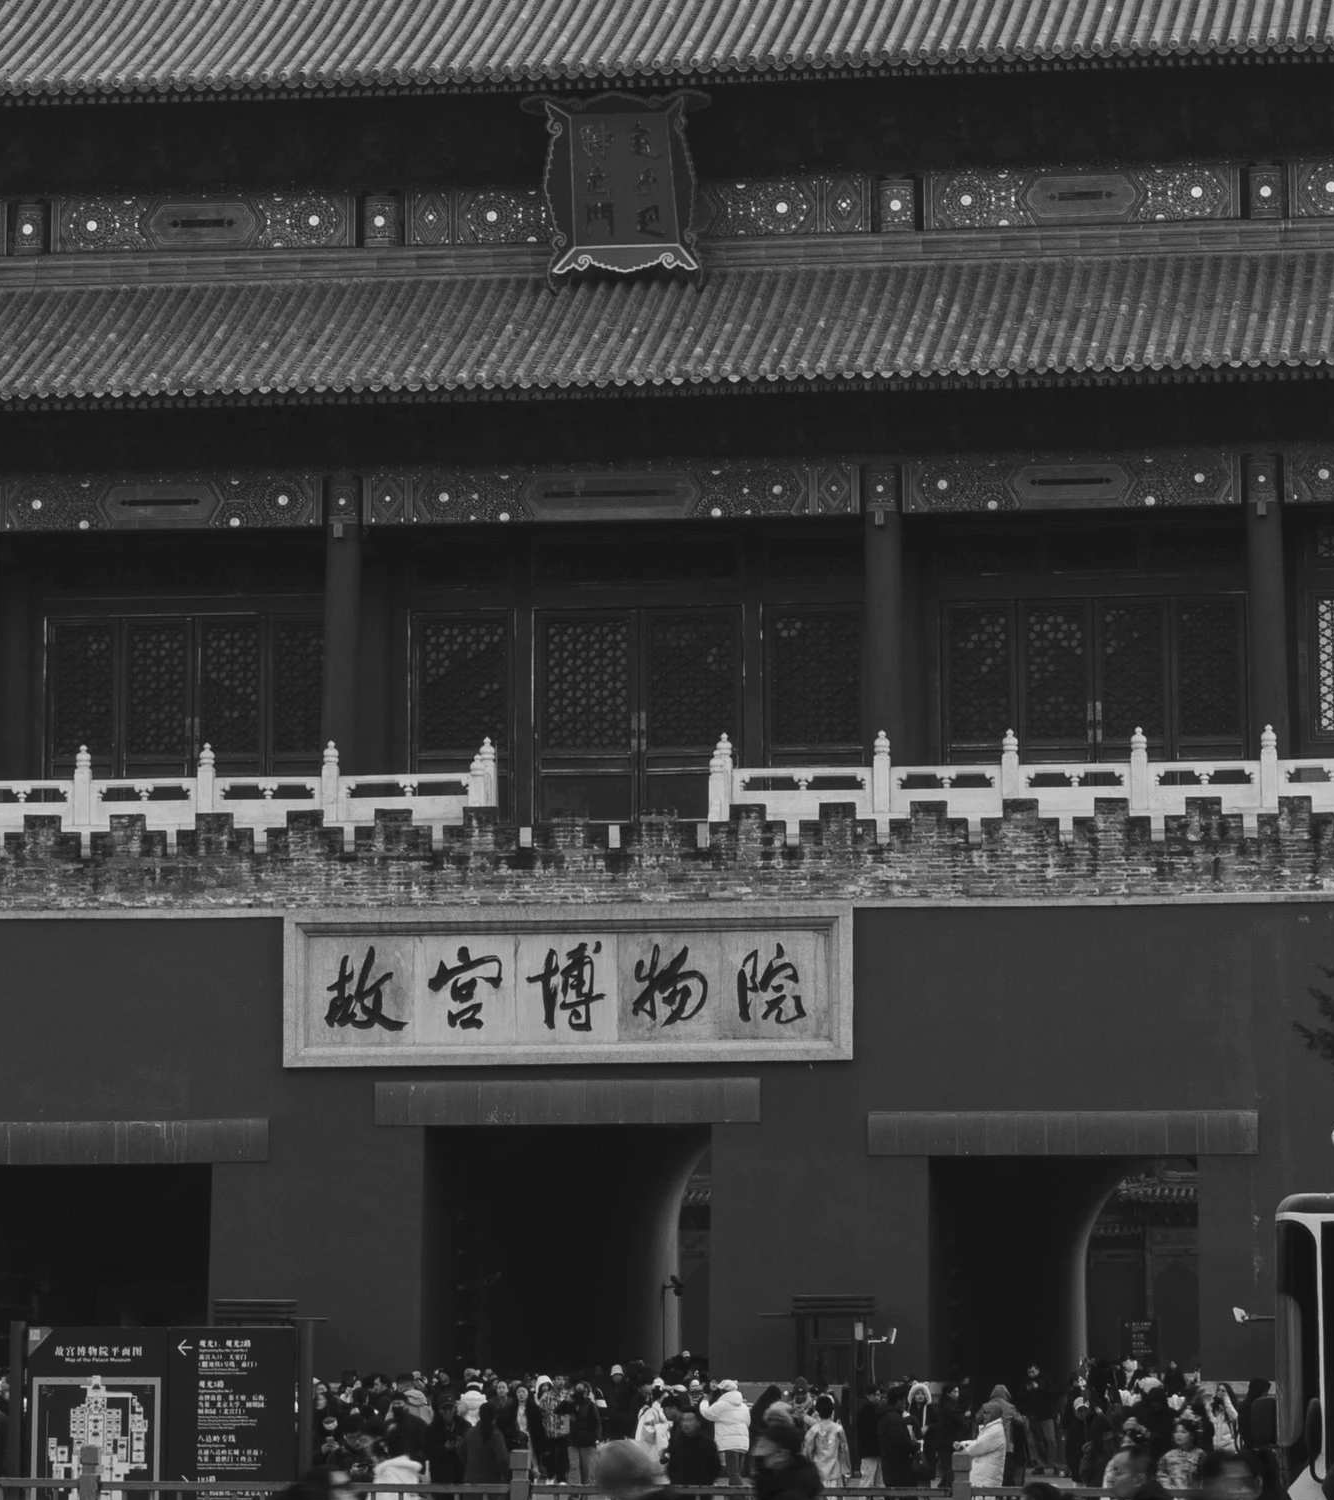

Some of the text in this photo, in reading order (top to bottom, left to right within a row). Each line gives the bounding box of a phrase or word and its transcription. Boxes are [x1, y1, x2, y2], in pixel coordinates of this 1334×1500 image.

[324, 941, 807, 1032] 故宫博物院
[54, 1345, 142, 1357] 故宫博物院平面图
